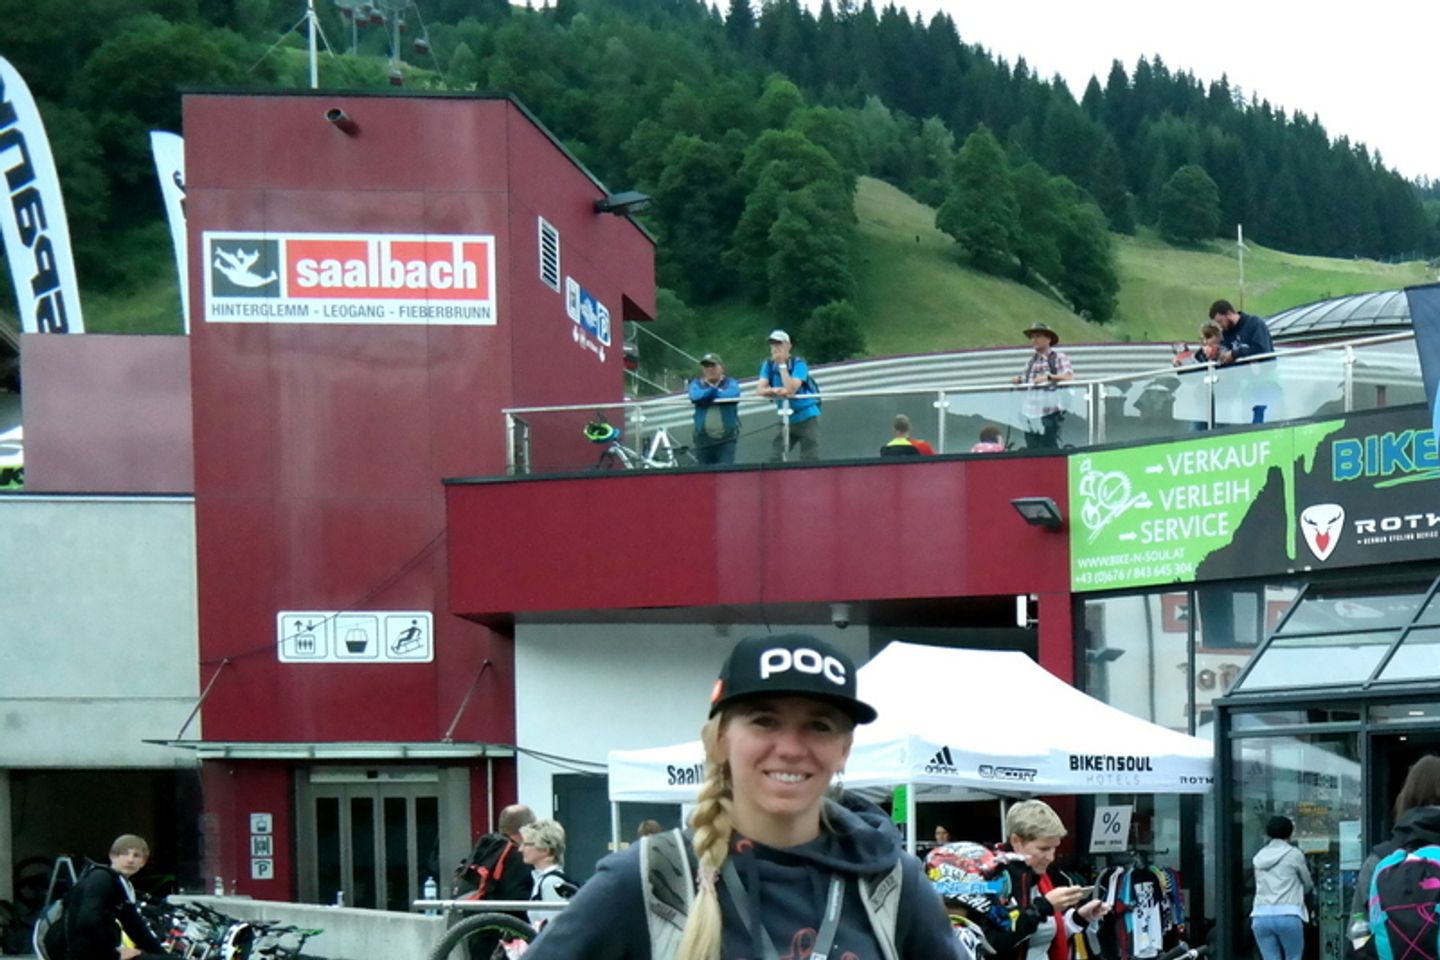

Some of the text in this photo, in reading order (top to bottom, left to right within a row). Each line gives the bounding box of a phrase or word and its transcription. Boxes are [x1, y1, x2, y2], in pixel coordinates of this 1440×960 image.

[296, 240, 478, 289] saalbach
[211, 304, 309, 317] HINTERGLEMM
[323, 305, 385, 318] LEOGANG
[399, 306, 491, 319] FIEBERBRUNN
[1166, 441, 1271, 476] VERKAUF
[1332, 429, 1440, 482] BIKE
[1158, 479, 1250, 511] VERLEIH
[1140, 512, 1229, 544] SERVICE
[666, 764, 704, 785] Saal
